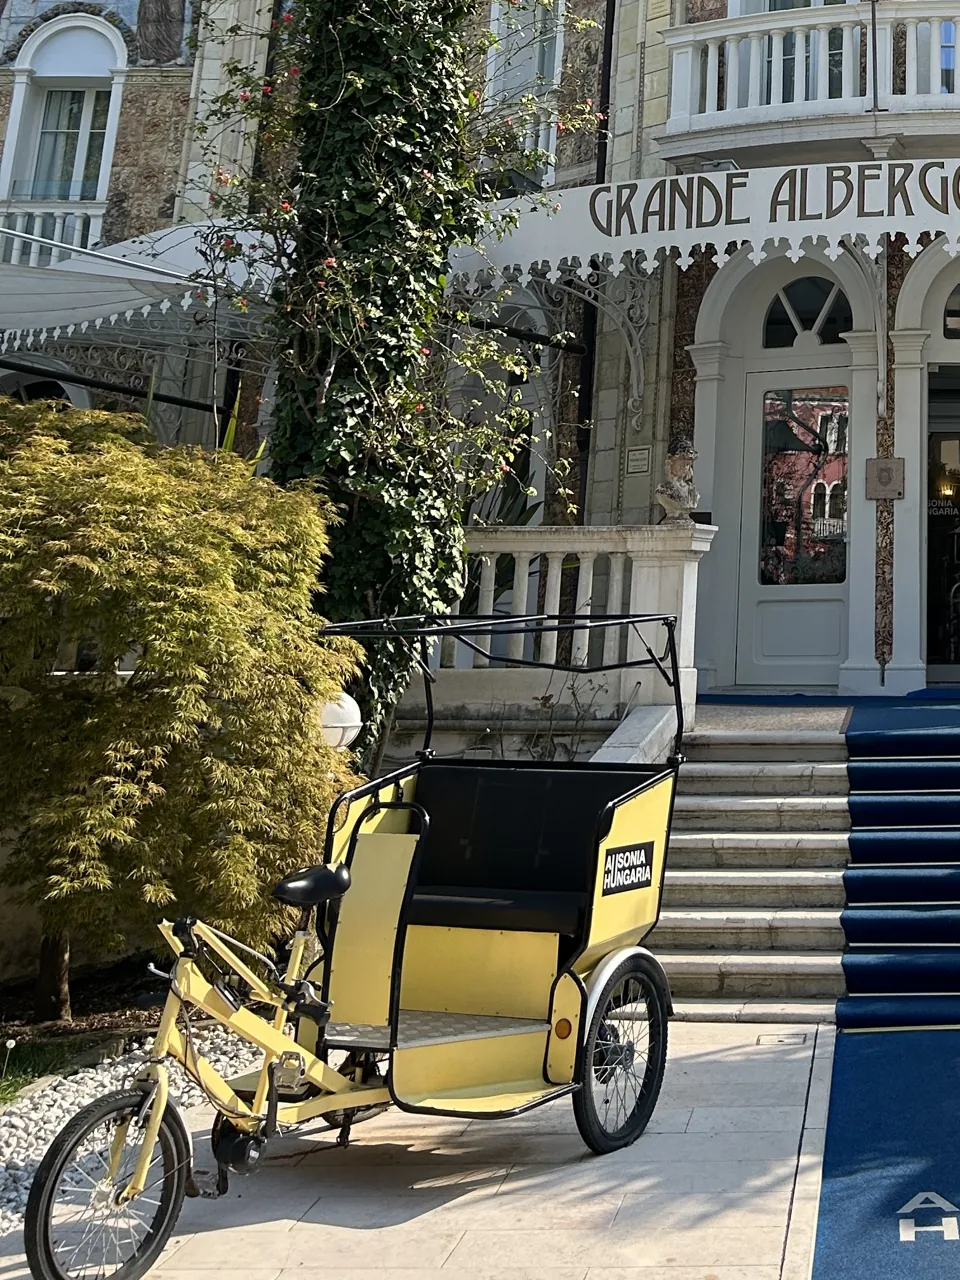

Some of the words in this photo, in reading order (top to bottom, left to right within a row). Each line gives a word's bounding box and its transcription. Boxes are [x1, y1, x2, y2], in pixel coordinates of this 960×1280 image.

[589, 171, 750, 237] GRANDE
[603, 854, 651, 889] HUNGARIA
[604, 849, 647, 887] AUSONIA
